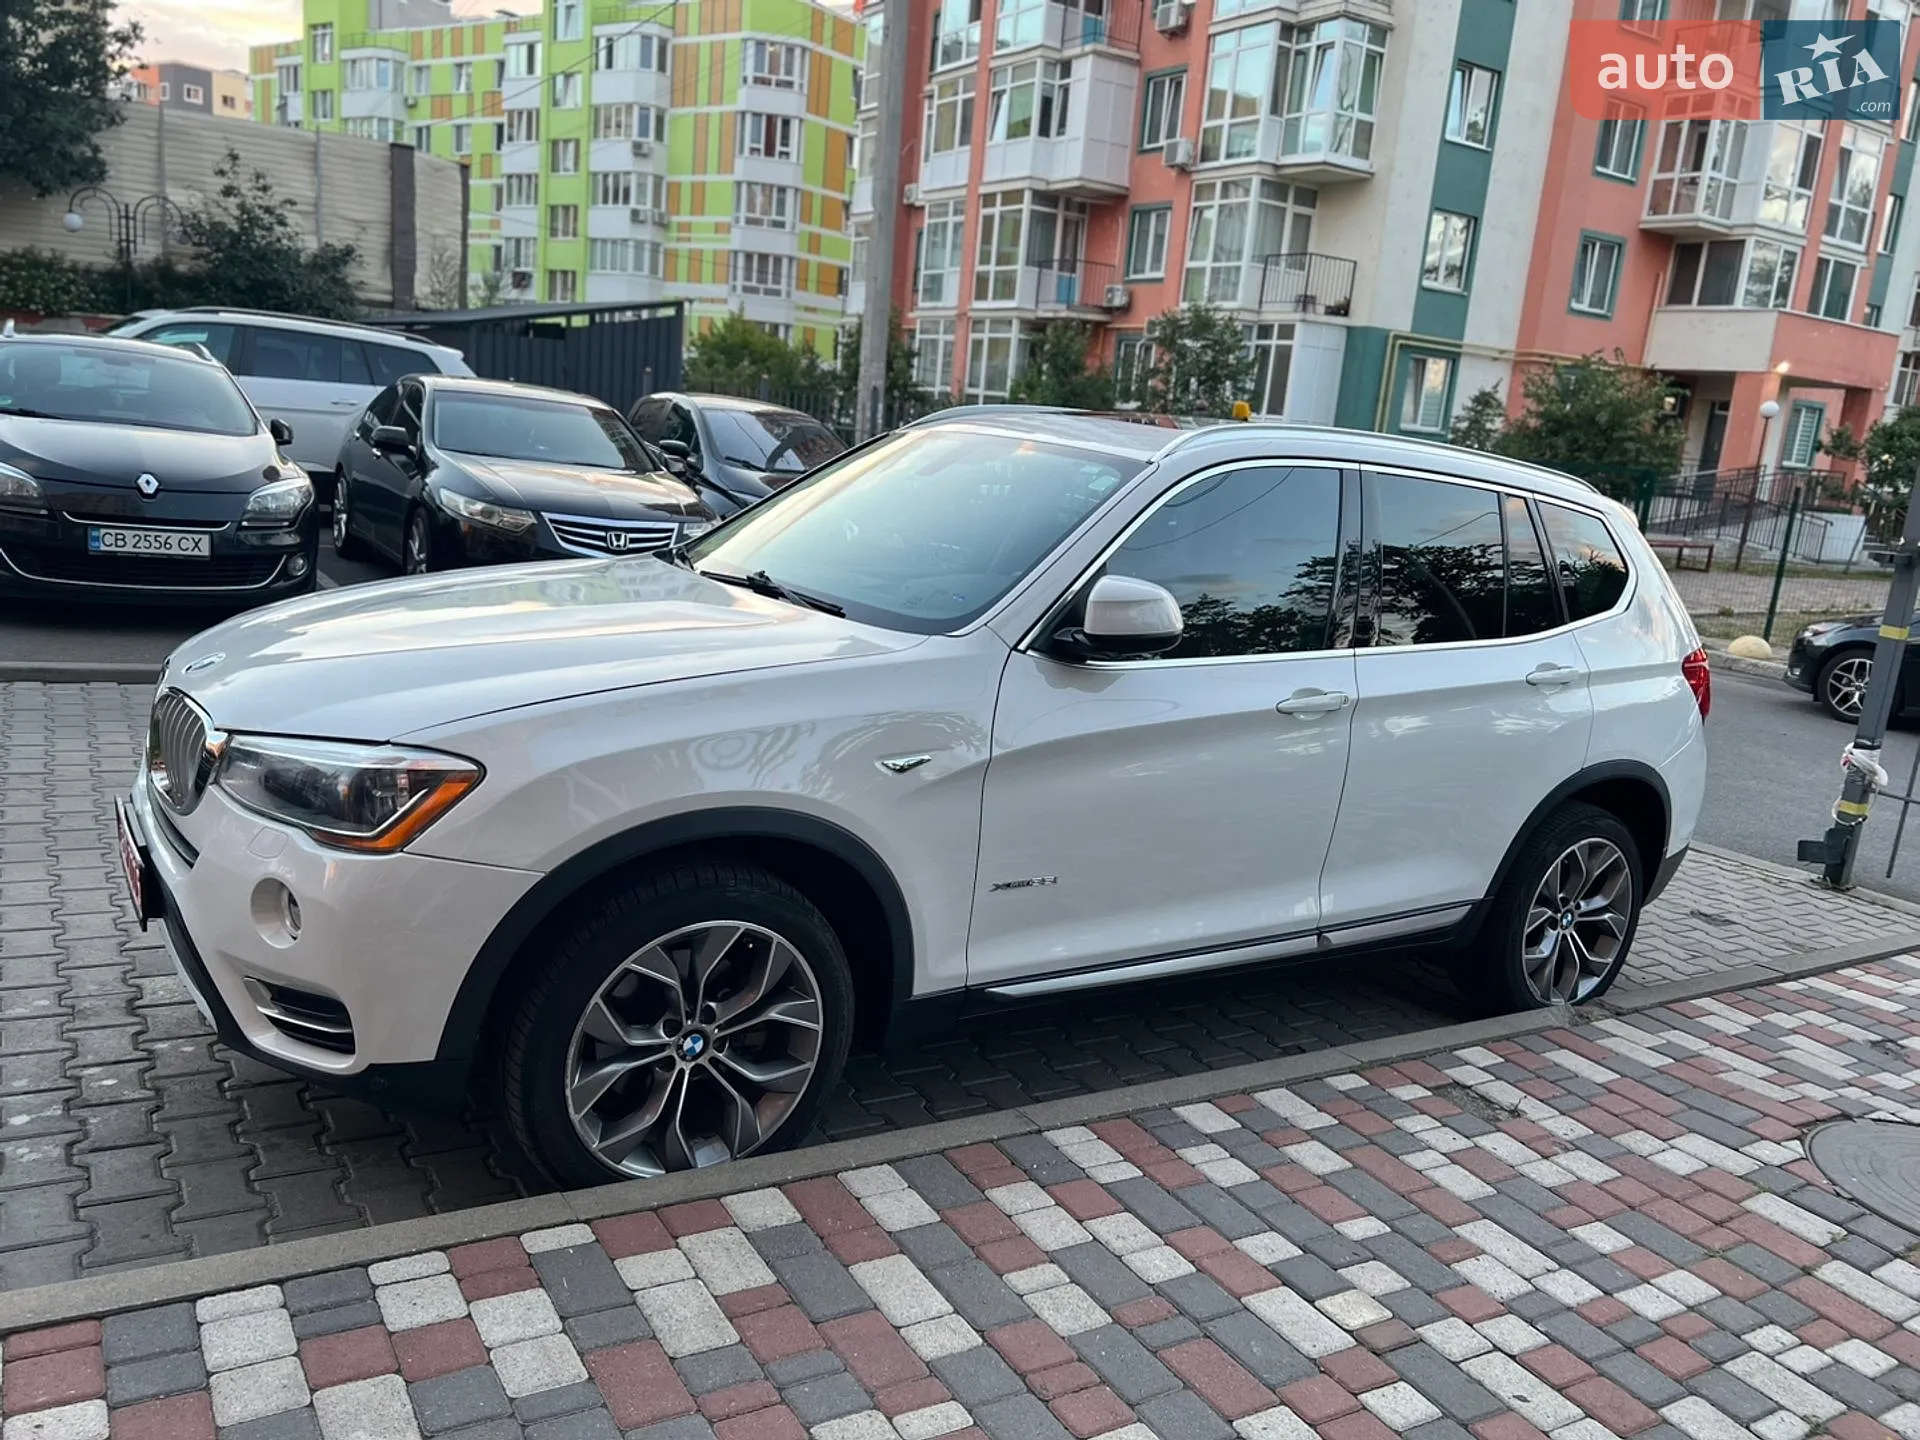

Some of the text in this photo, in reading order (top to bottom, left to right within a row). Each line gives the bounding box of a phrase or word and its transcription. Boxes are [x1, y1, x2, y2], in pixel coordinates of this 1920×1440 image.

[101, 532, 203, 553] CB 2556 CX
